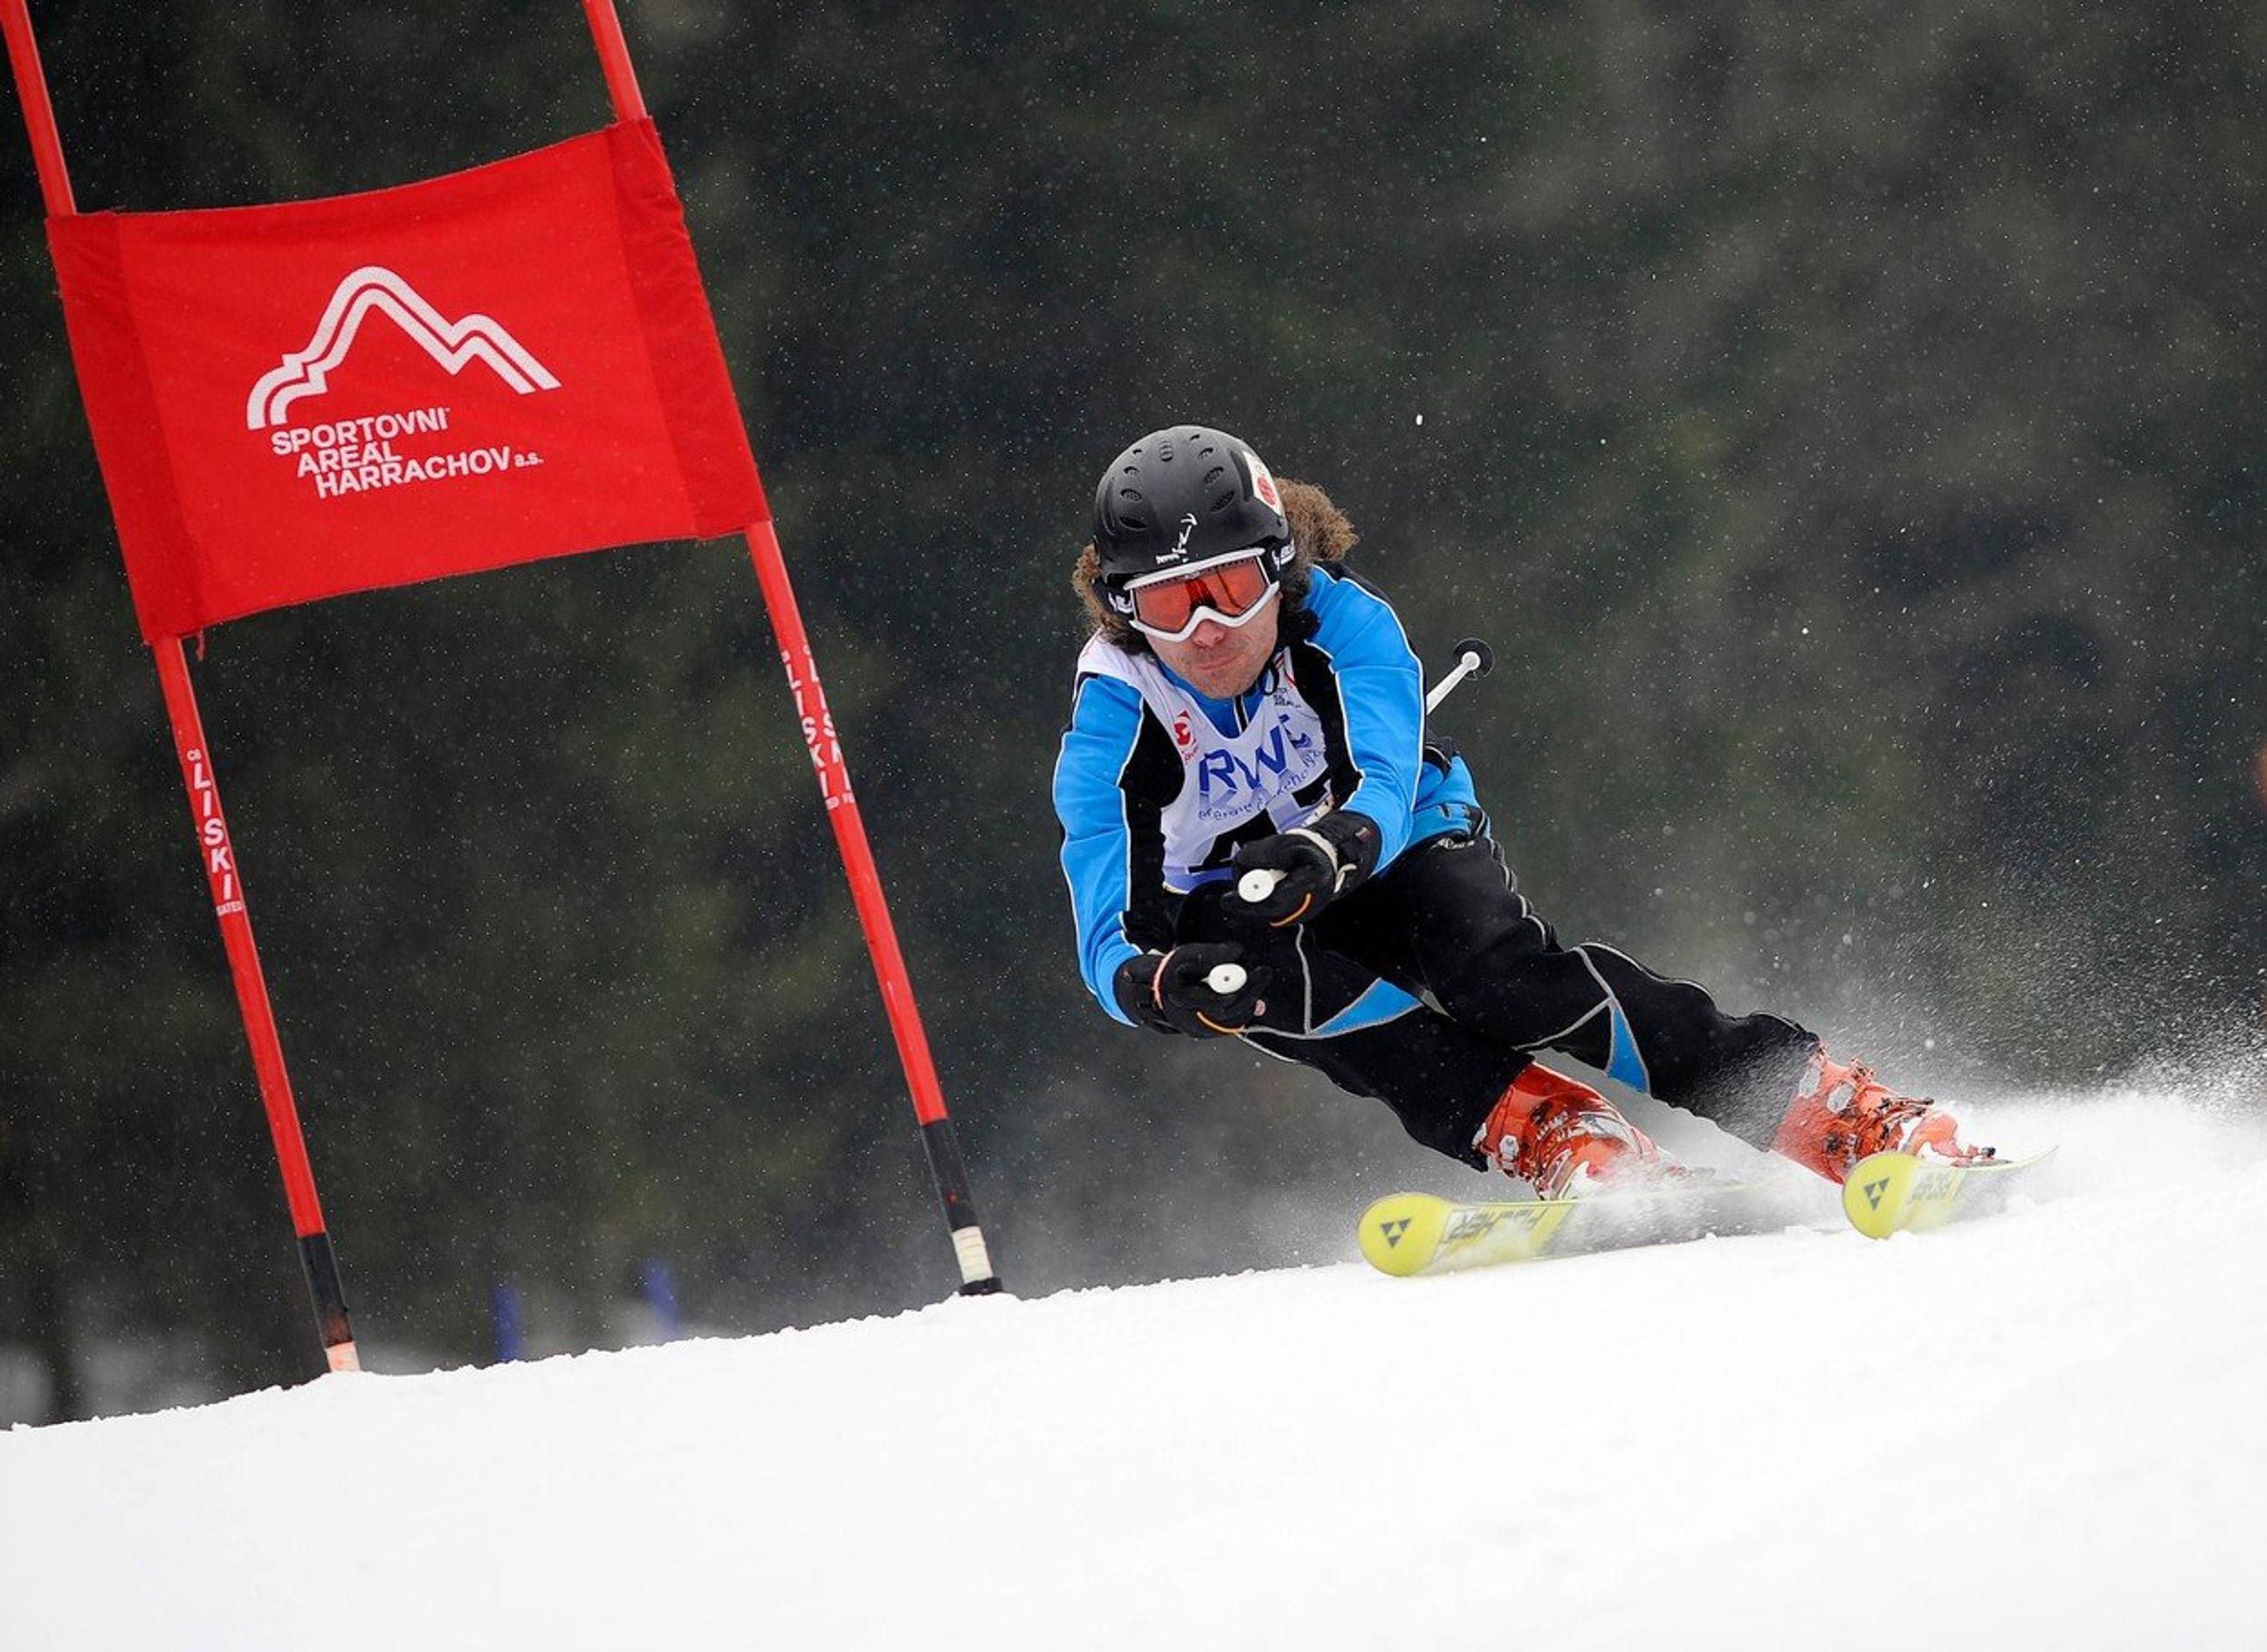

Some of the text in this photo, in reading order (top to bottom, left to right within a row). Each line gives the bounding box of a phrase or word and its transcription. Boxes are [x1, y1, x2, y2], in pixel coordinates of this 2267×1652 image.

[315, 447, 543, 499] HARRACHOV a.s.
[194, 762, 233, 900] LISKI
